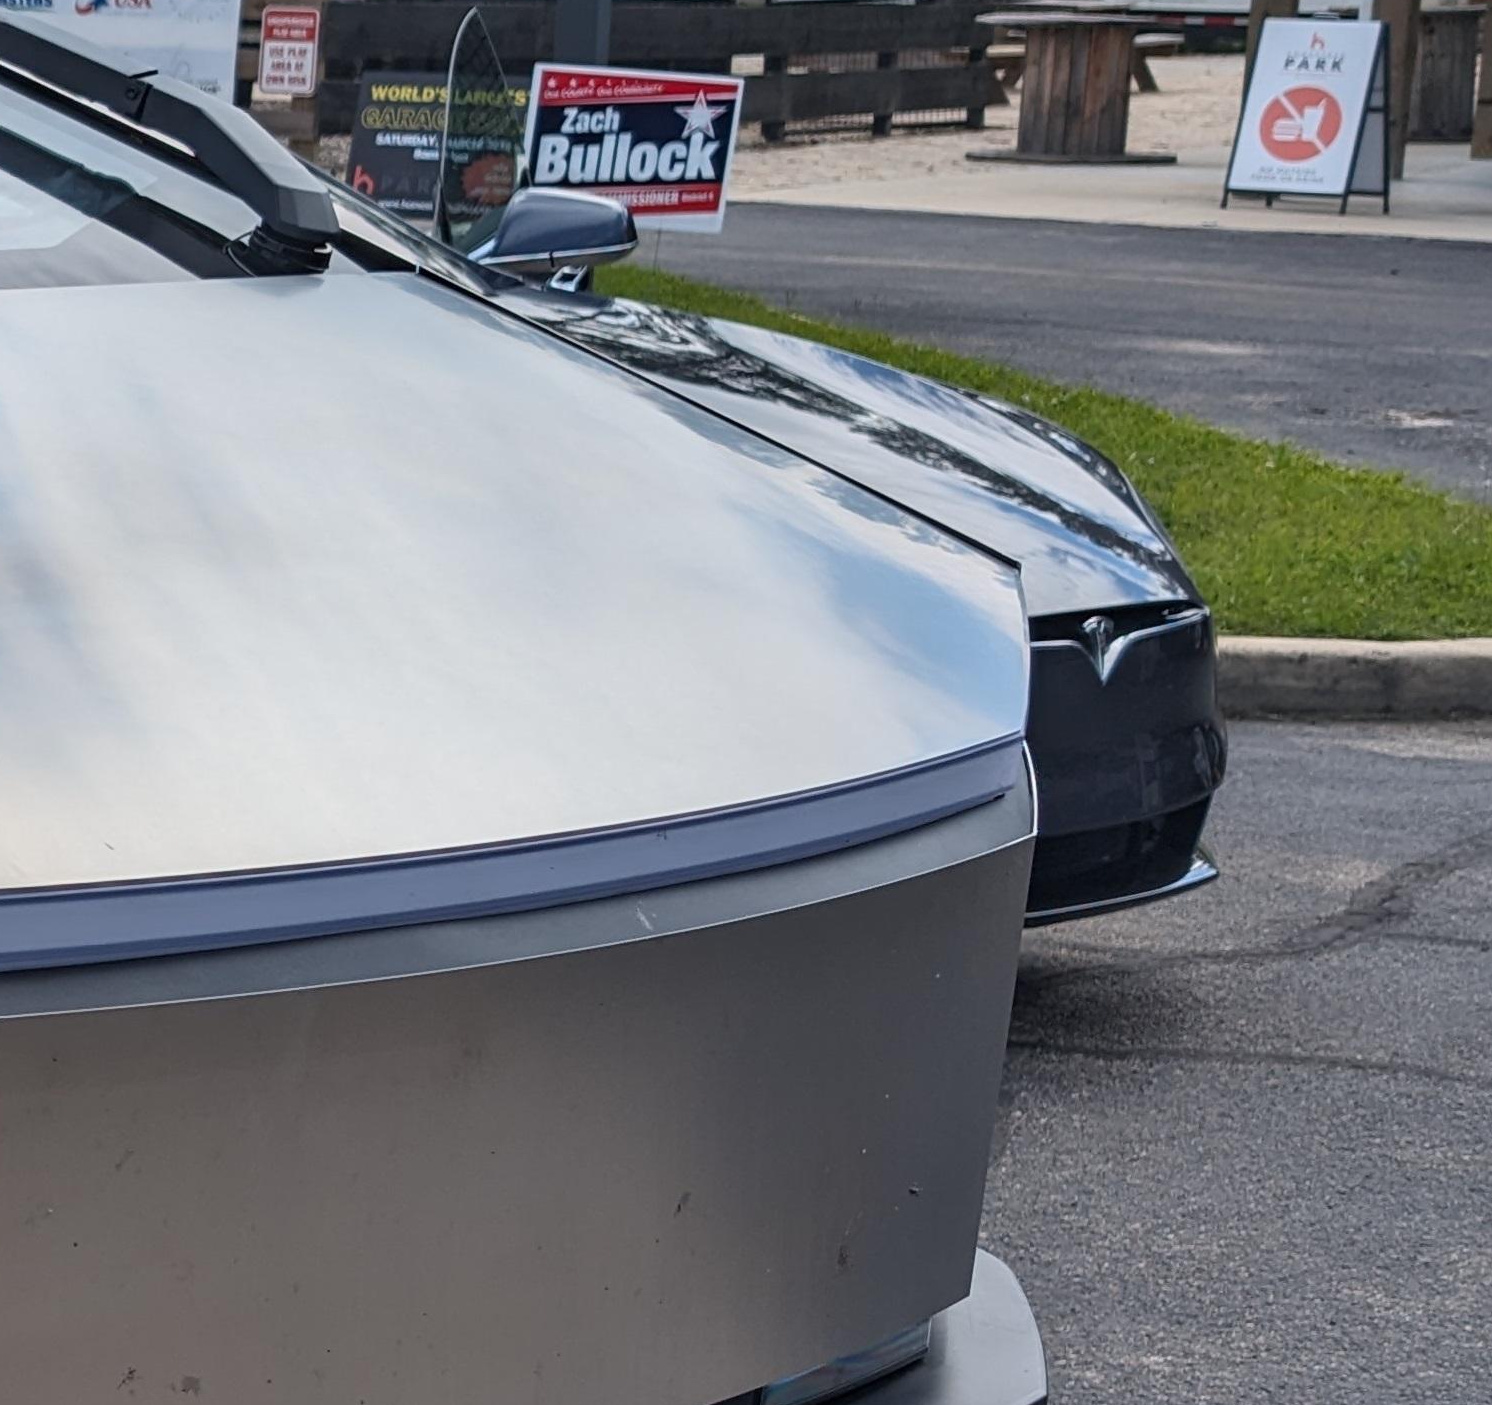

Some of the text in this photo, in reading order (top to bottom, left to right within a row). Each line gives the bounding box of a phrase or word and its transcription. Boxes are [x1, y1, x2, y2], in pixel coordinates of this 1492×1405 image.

[1282, 56, 1346, 73] PARK
[371, 84, 450, 104] WORLD'S
[560, 105, 622, 134] Zach
[533, 131, 721, 185] Bullock
